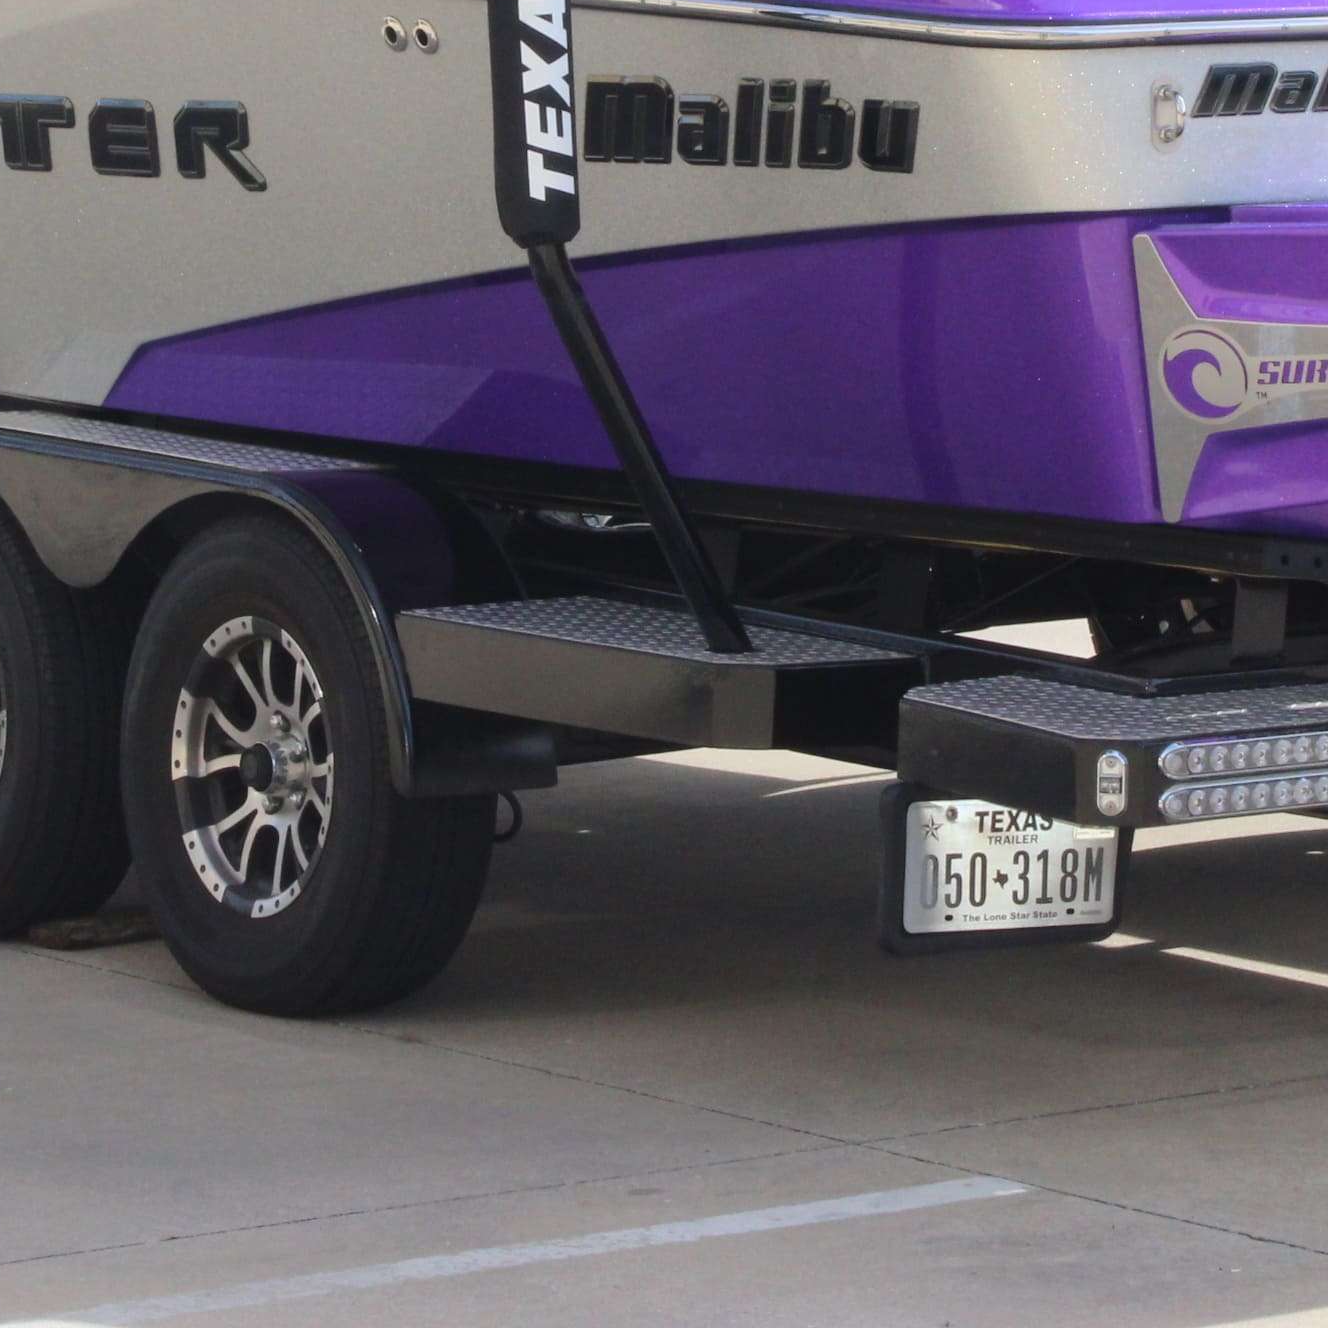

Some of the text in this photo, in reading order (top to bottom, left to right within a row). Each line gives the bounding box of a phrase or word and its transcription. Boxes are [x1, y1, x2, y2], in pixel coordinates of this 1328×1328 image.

[583, 74, 920, 173] Malibu
[974, 809, 1054, 833] TEXAS
[987, 834, 1039, 846] TRAILER
[1011, 845, 1105, 906] 318M
[962, 910, 1058, 923] The Lone Star State
